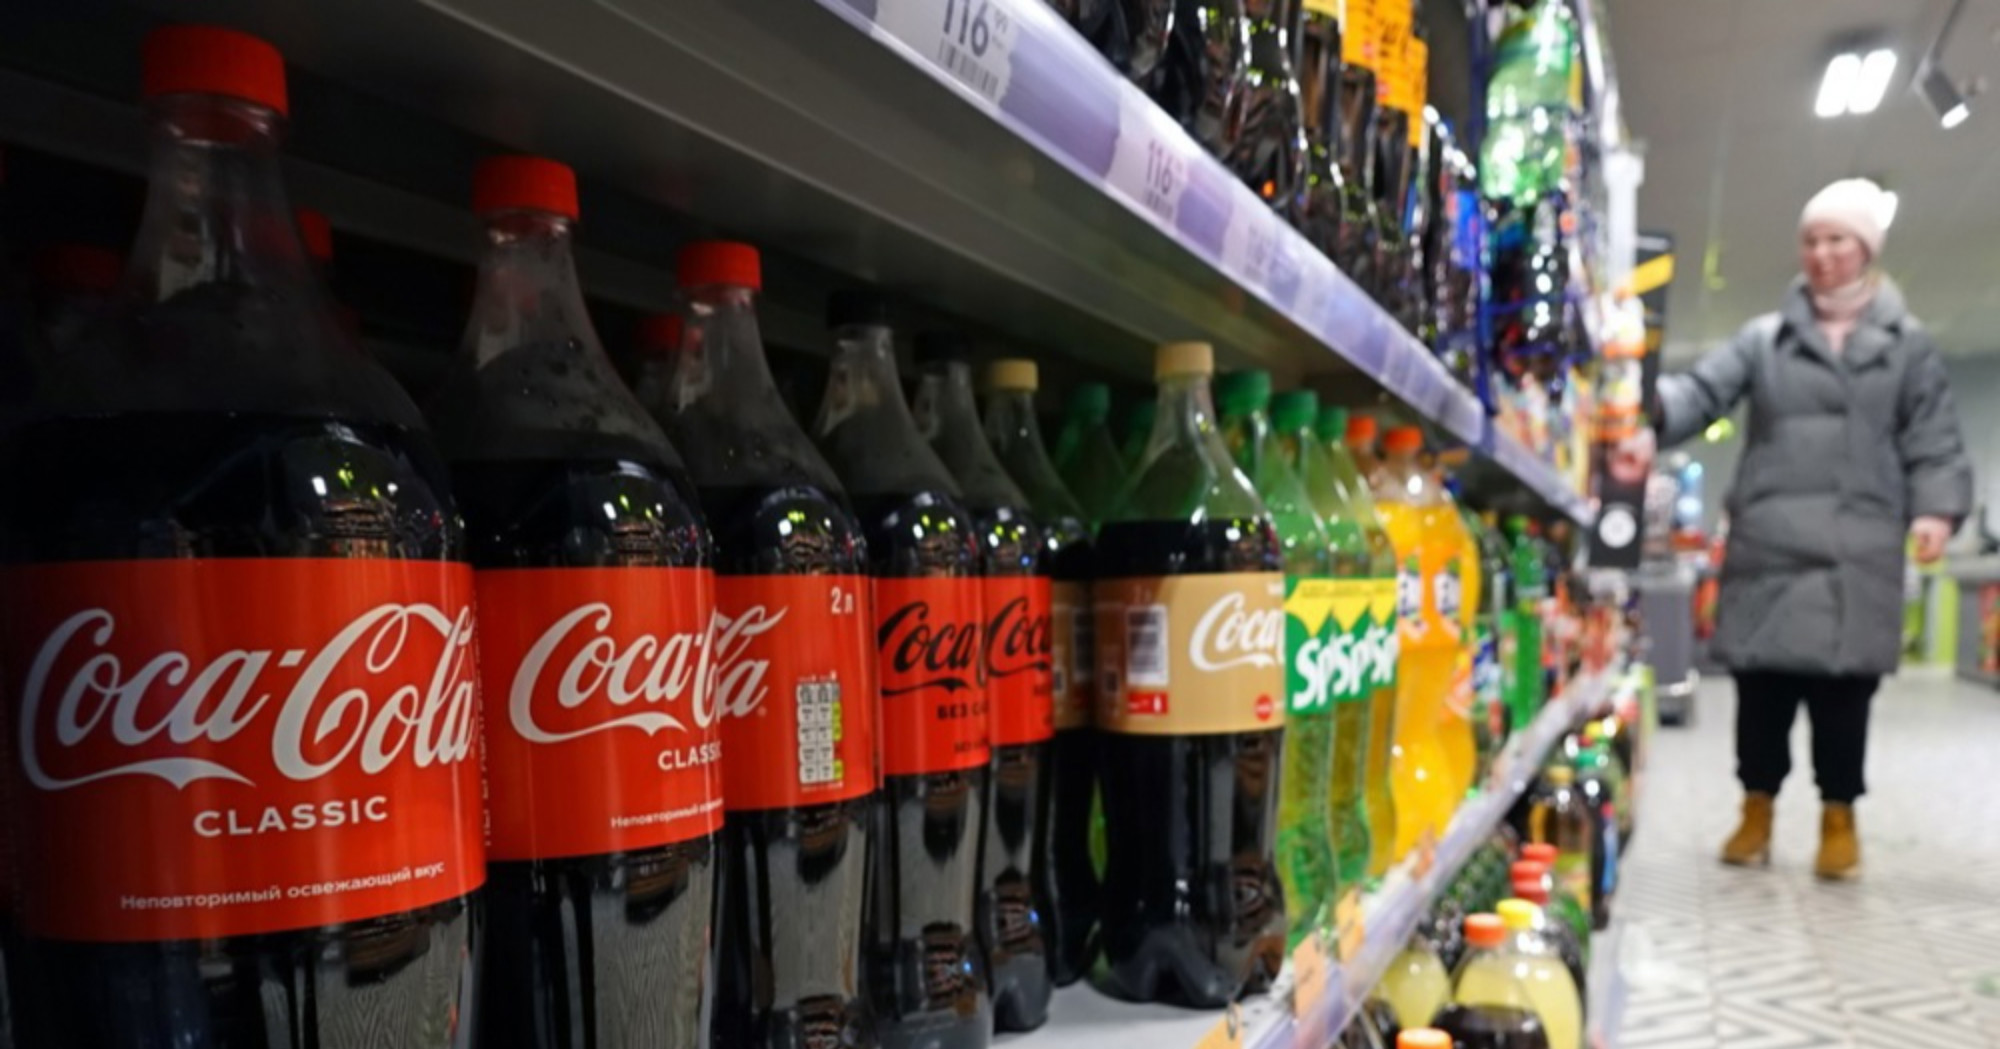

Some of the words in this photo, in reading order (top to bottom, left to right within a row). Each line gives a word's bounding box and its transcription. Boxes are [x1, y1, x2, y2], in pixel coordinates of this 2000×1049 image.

[831, 587, 842, 614] 2
[20, 602, 475, 790] Coca-Cola
[193, 796, 389, 838] CLASSIC
[121, 887, 281, 911] Неповторимый
[287, 866, 411, 899] освежающий
[415, 861, 445, 880] вкус
